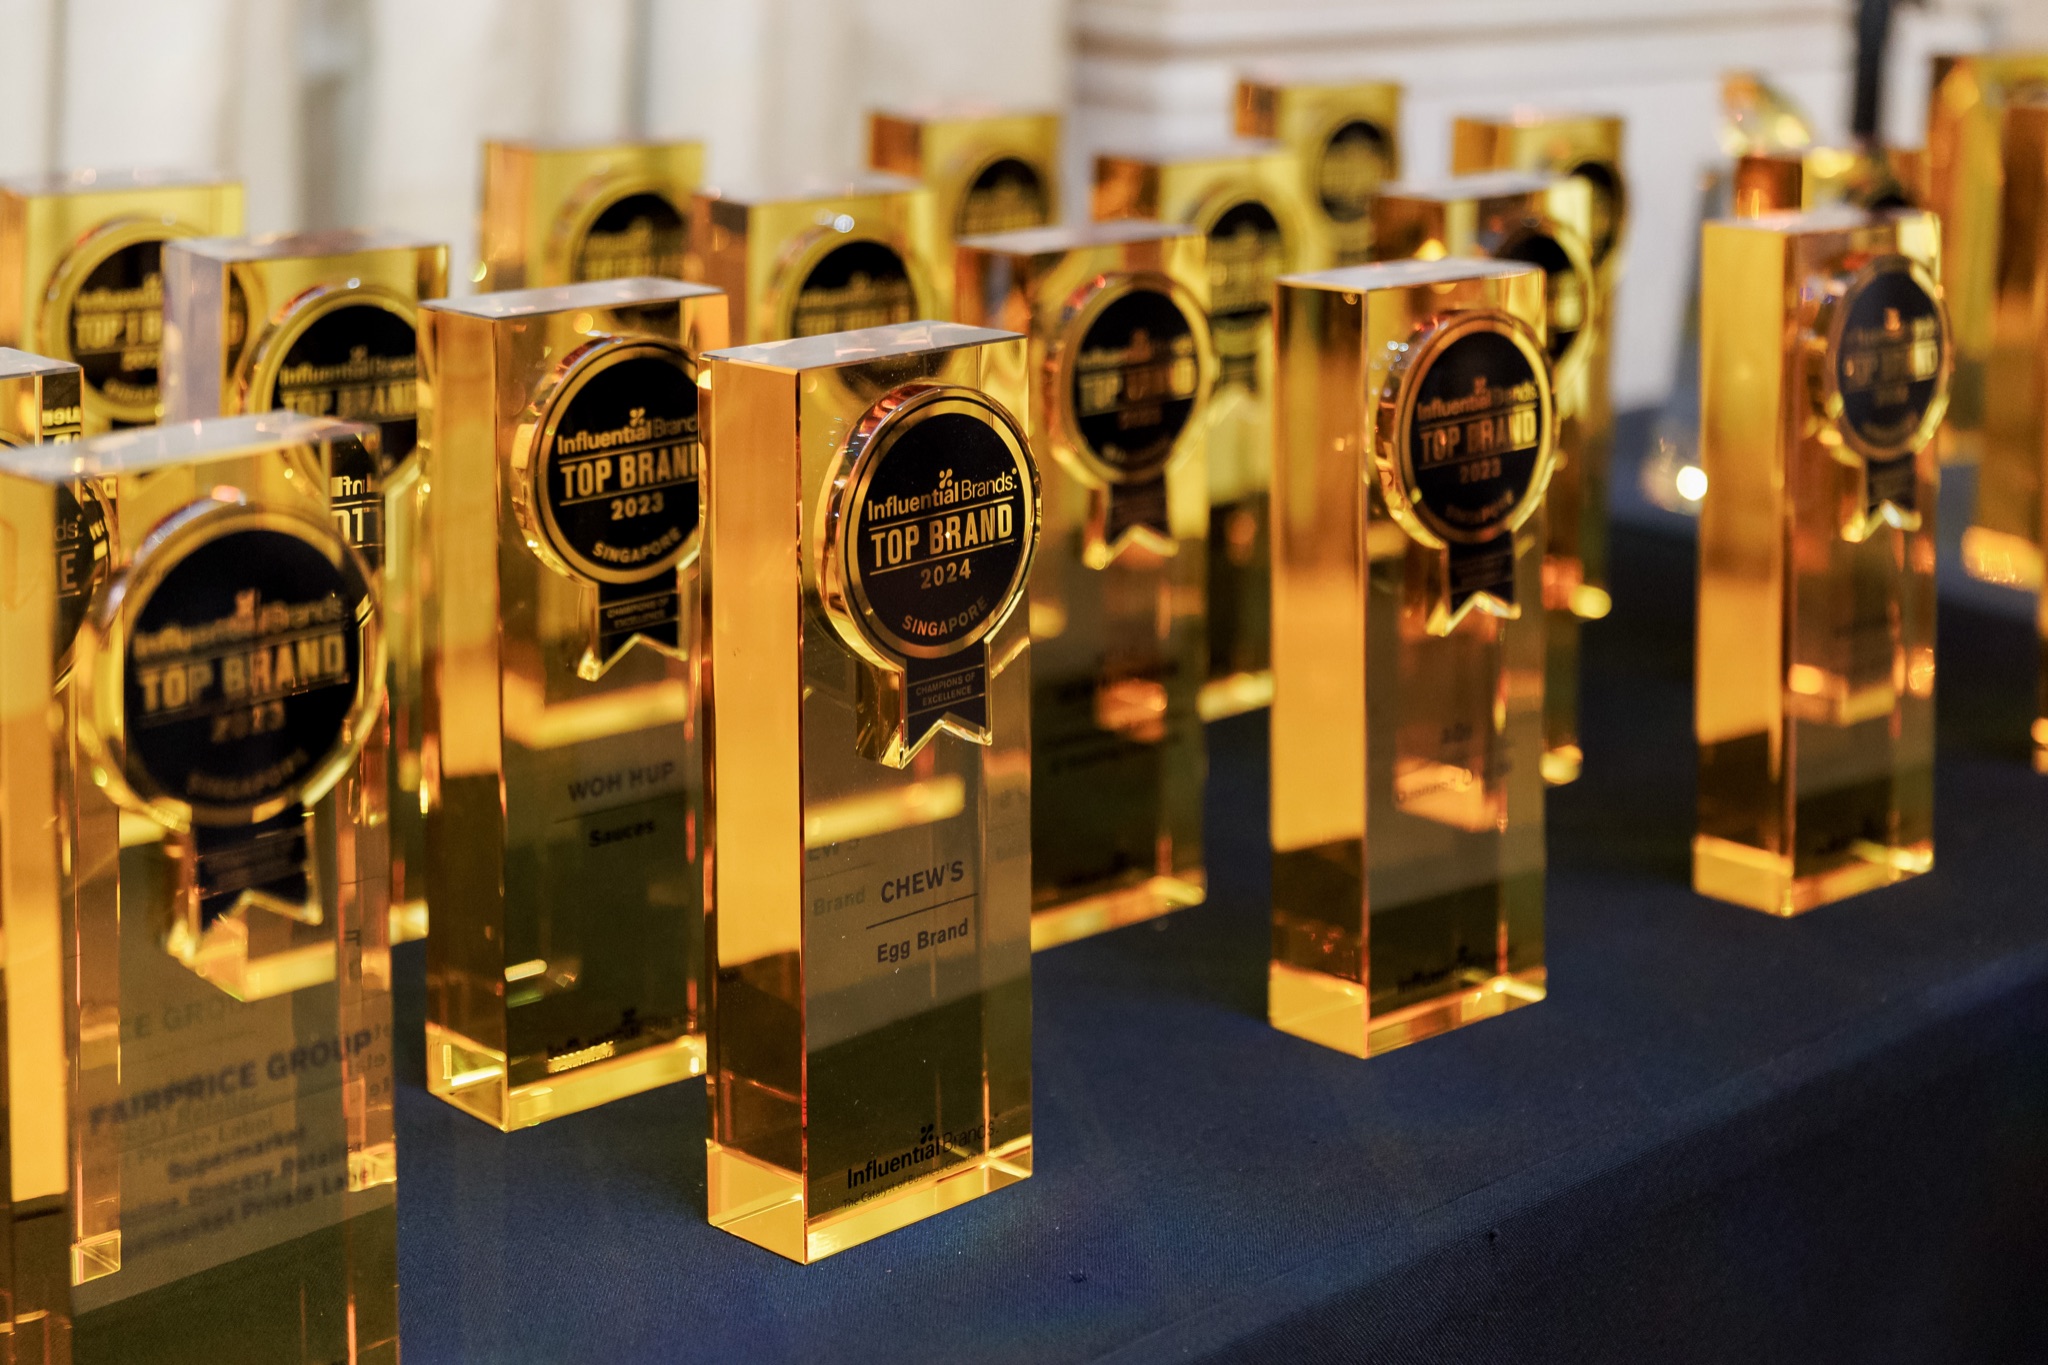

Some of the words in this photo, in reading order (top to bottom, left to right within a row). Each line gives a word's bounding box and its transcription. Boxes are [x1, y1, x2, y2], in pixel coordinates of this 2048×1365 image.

[557, 422, 652, 456] Influential
[1420, 425, 1461, 464] TOP
[1466, 408, 1537, 451] BRAND
[560, 459, 613, 499] TOP
[611, 492, 665, 521] 2023
[868, 480, 960, 522] Influential
[592, 525, 683, 564] SINGAPORE
[871, 525, 920, 568] TOP
[928, 503, 1013, 552] BRAND
[920, 557, 972, 590] 2024
[902, 596, 987, 637] SINGAPORE
[139, 660, 215, 714] TOP
[220, 632, 348, 702] BRAND
[915, 674, 963, 697] CHAMPIONS
[964, 671, 976, 683] OF
[922, 684, 972, 706] EXCELLENCE
[567, 770, 623, 802] WOH
[628, 759, 675, 789] HUP
[880, 860, 965, 904] CHEW'S
[876, 938, 910, 964] Egg
[916, 917, 969, 951] Brand
[89, 1060, 257, 1136] FAIRPRICE
[266, 1029, 373, 1082] GROUP
[847, 1135, 940, 1190] Influential
[843, 1196, 858, 1209] The
[861, 1183, 896, 1203] Catalyst
[908, 1166, 945, 1185] Business
